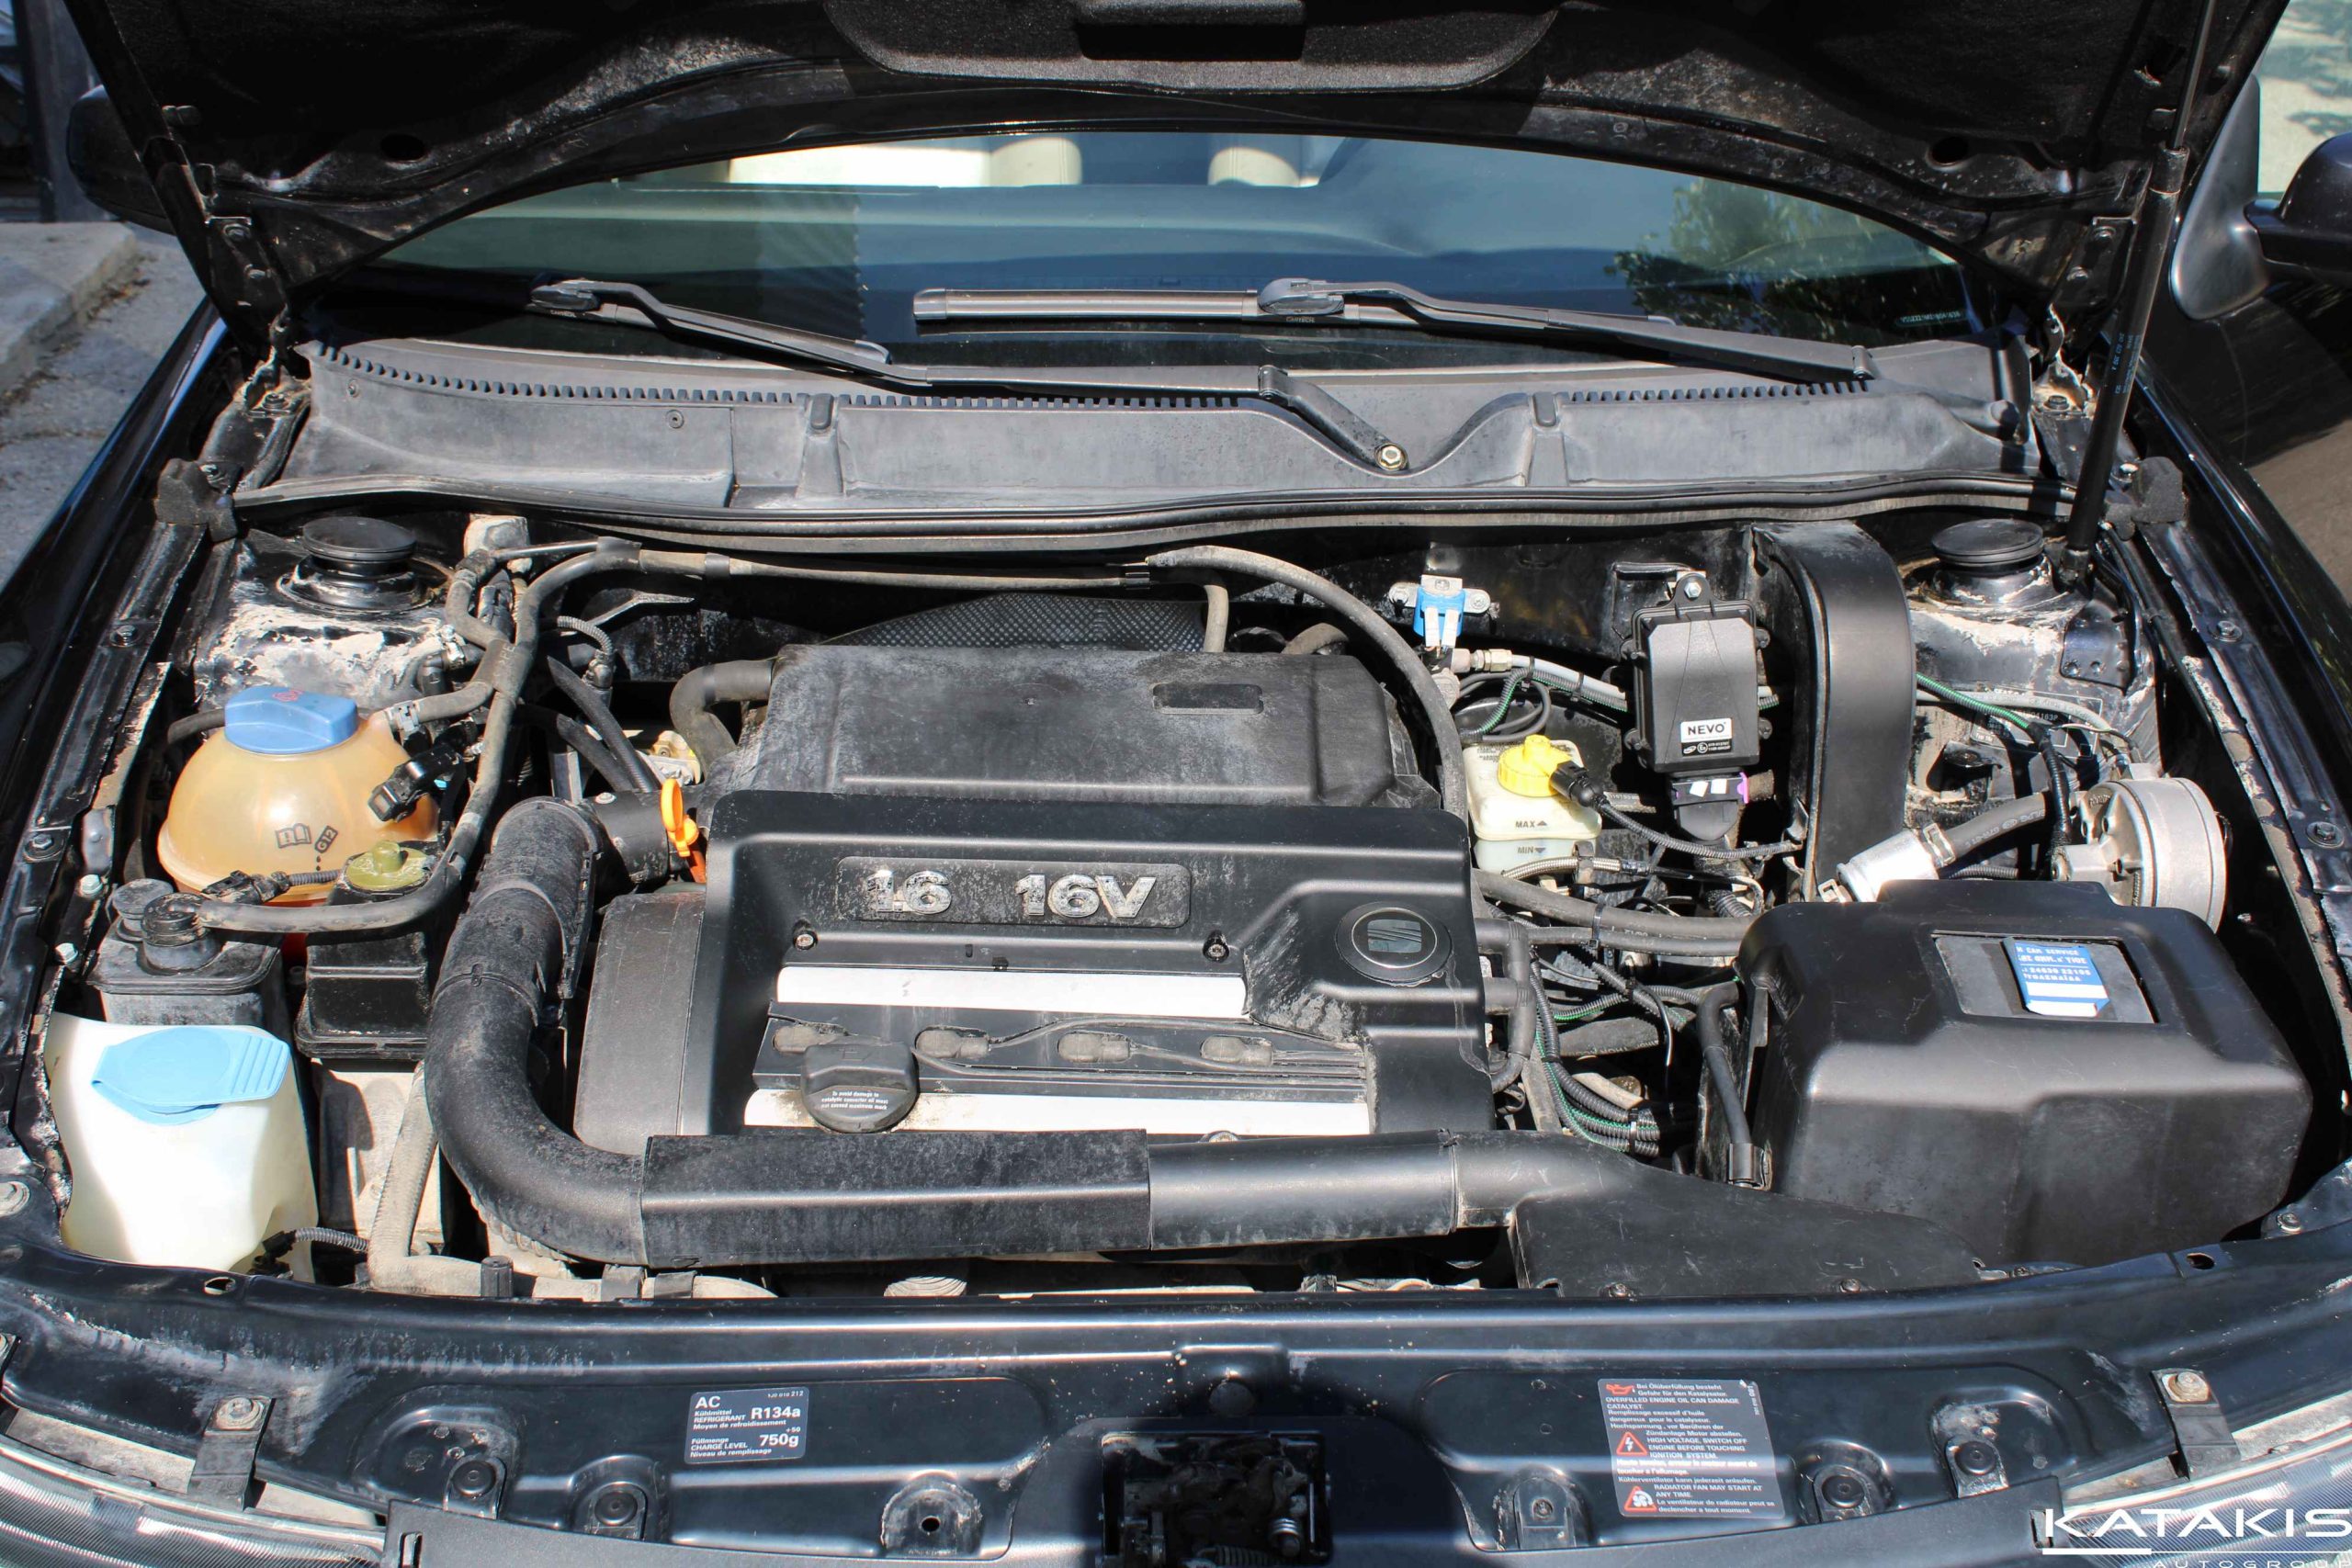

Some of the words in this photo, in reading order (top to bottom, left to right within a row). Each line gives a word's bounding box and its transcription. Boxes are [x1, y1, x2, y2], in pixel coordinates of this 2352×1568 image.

[1688, 724, 1724, 735] NEVO
[317, 829, 336, 851] G12
[866, 869, 953, 915] 1.6
[1014, 874, 1157, 919] 16V
[2045, 948, 2079, 956] SERVICE
[1649, 1382, 1695, 1391] Ölüberfüllung
[695, 1396, 721, 1409] AC
[752, 1406, 801, 1419] R134a
[694, 1415, 746, 1423] REFRIGERANT
[730, 1420, 786, 1428] refroidissement
[759, 1434, 799, 1448] 750g
[691, 1443, 724, 1451] CHARGE
[728, 1448, 772, 1456] remplissage
